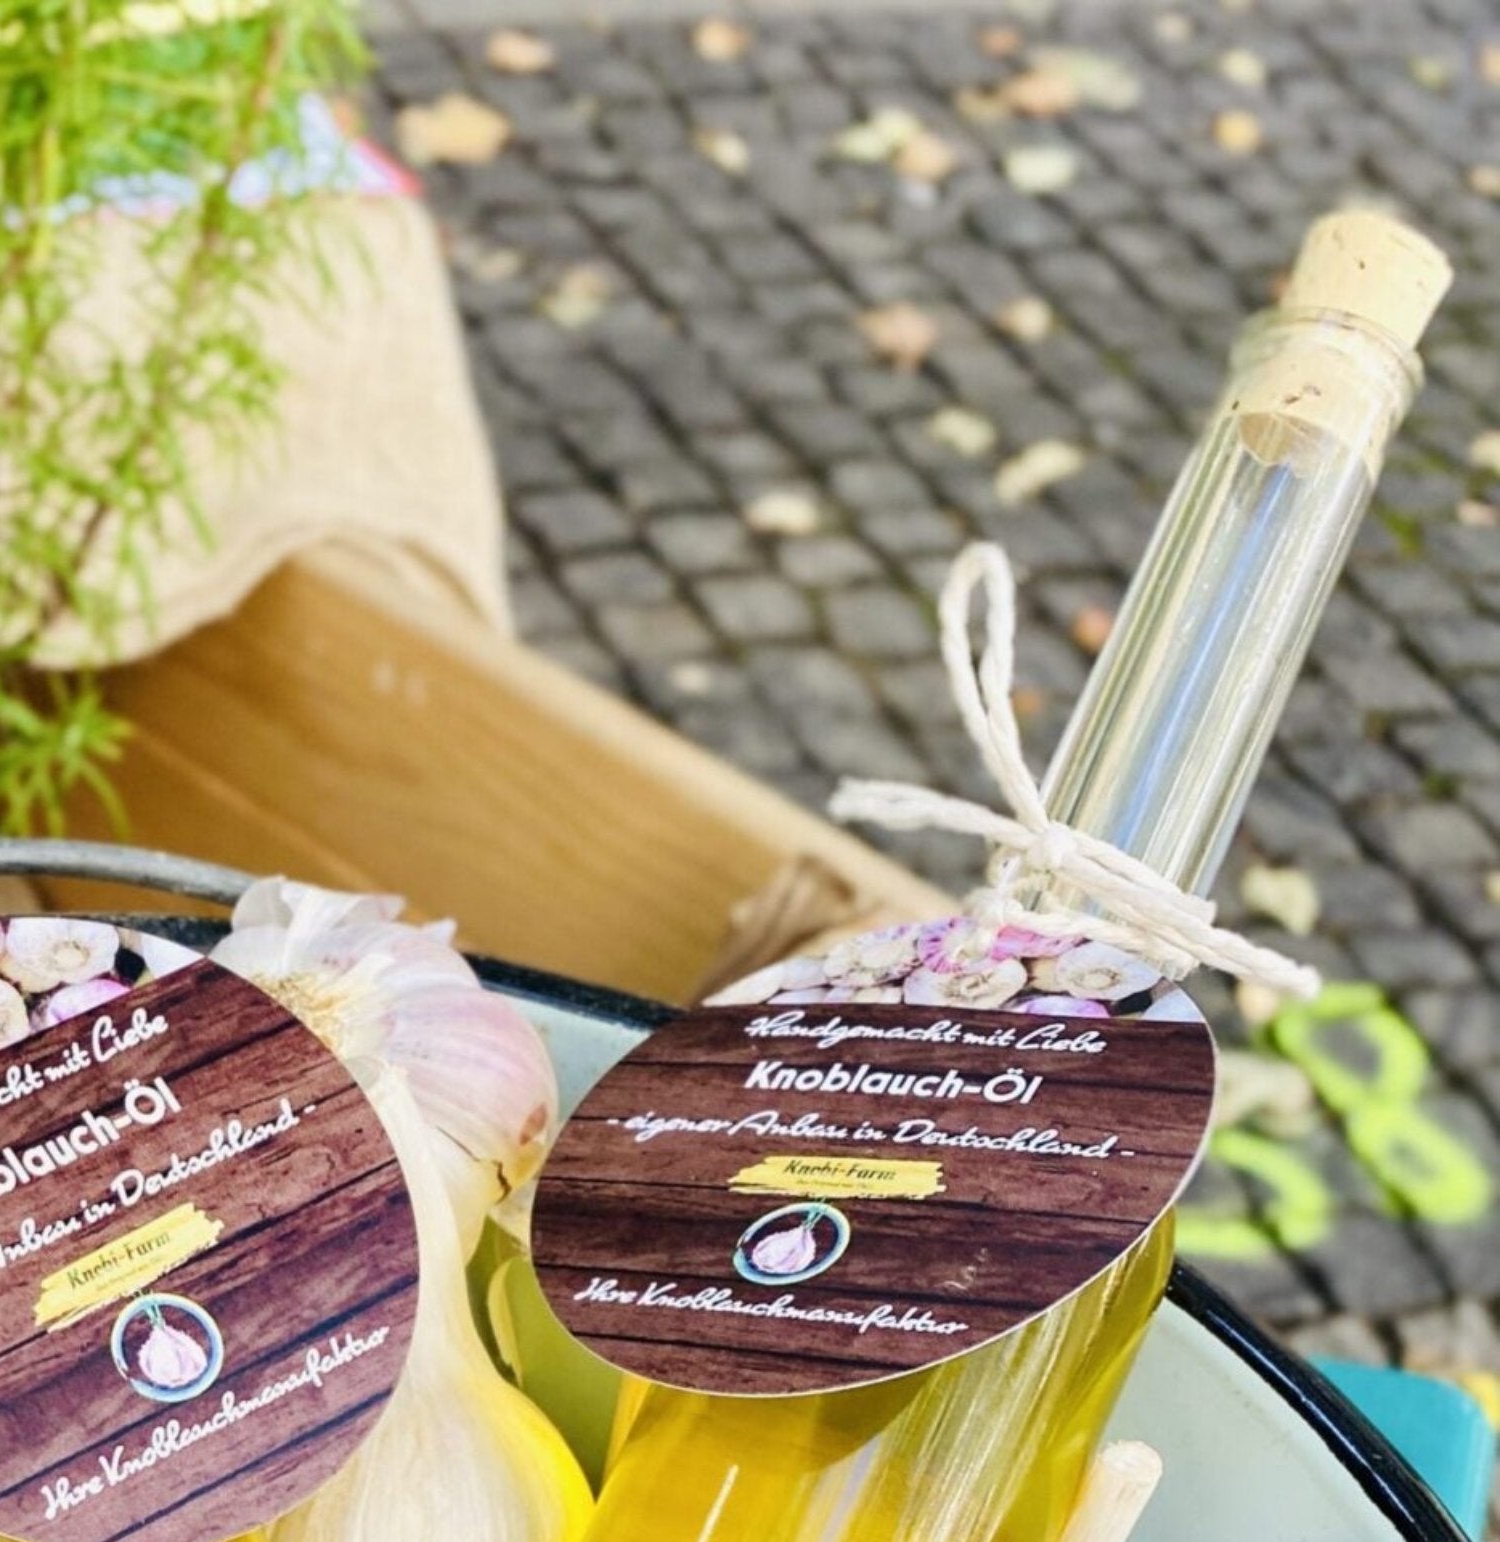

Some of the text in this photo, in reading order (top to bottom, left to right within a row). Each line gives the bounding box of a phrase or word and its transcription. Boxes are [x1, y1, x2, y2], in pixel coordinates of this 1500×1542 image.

[45, 1041, 91, 1083] mit
[92, 1007, 169, 1063] Liebe
[744, 1010, 1108, 1053] Handgemacht mit Liebe
[744, 1060, 1043, 1104] Knoblauch-Öl
[81, 1199, 116, 1226] in
[111, 1098, 300, 1205] Deutschland
[624, 1111, 731, 1143] eigener
[728, 1110, 848, 1139] Anbau
[853, 1121, 886, 1141] in
[893, 1118, 1119, 1158] Deutschland
[573, 1277, 968, 1334] Ihre Knoblauchmanufaktur
[40, 1326, 390, 1520] Ihre Knoblauchmanufaktur
